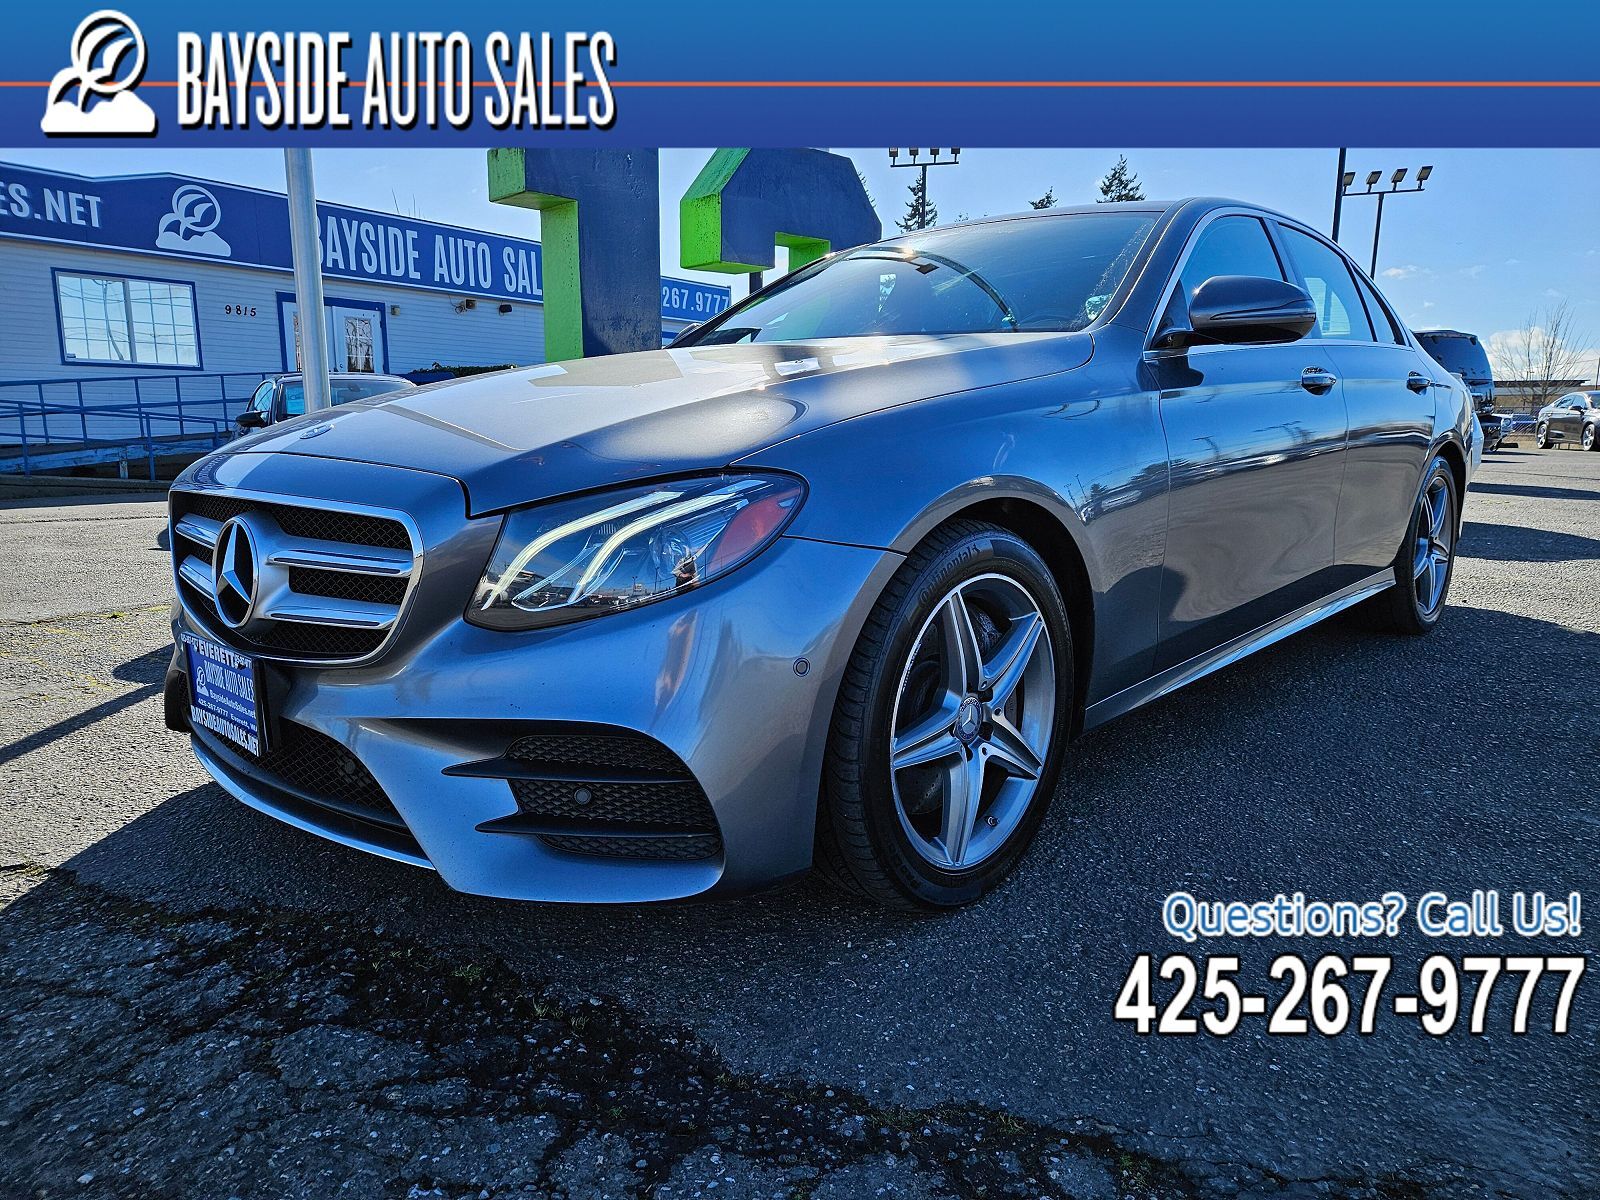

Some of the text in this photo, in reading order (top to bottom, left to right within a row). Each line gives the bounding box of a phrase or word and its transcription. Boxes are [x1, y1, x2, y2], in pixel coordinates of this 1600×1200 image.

[317, 215, 421, 280] AYSIDE
[434, 234, 492, 289] AUTO
[224, 304, 257, 317] 9815
[662, 286, 729, 314] 267.9777
[199, 639, 235, 668] EVERETT
